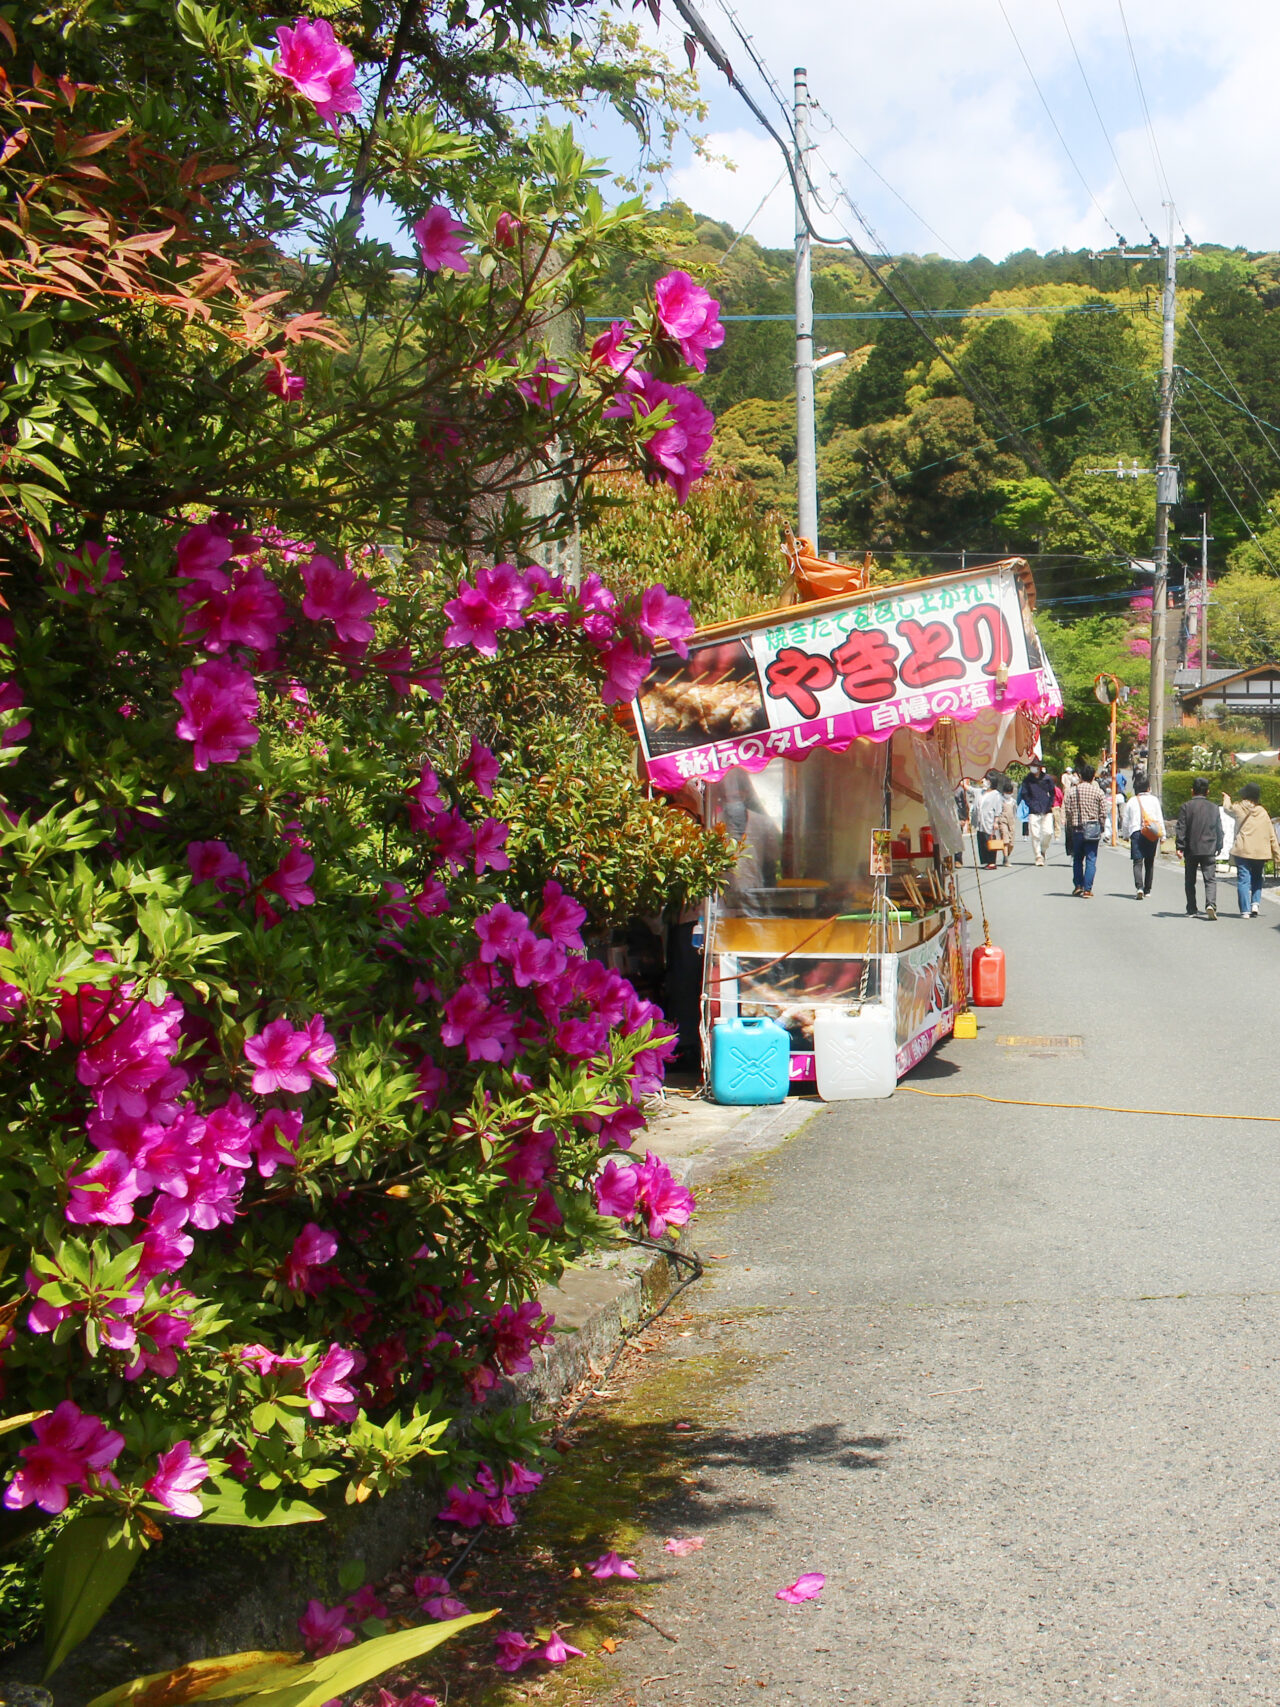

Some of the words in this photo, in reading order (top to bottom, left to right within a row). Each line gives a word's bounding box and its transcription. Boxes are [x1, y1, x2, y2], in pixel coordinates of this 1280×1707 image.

[766, 578, 994, 651] 焼きたてを召し上がれ!
[765, 603, 1013, 720] やきとり
[676, 717, 835, 778] 秘伝のタレ!
